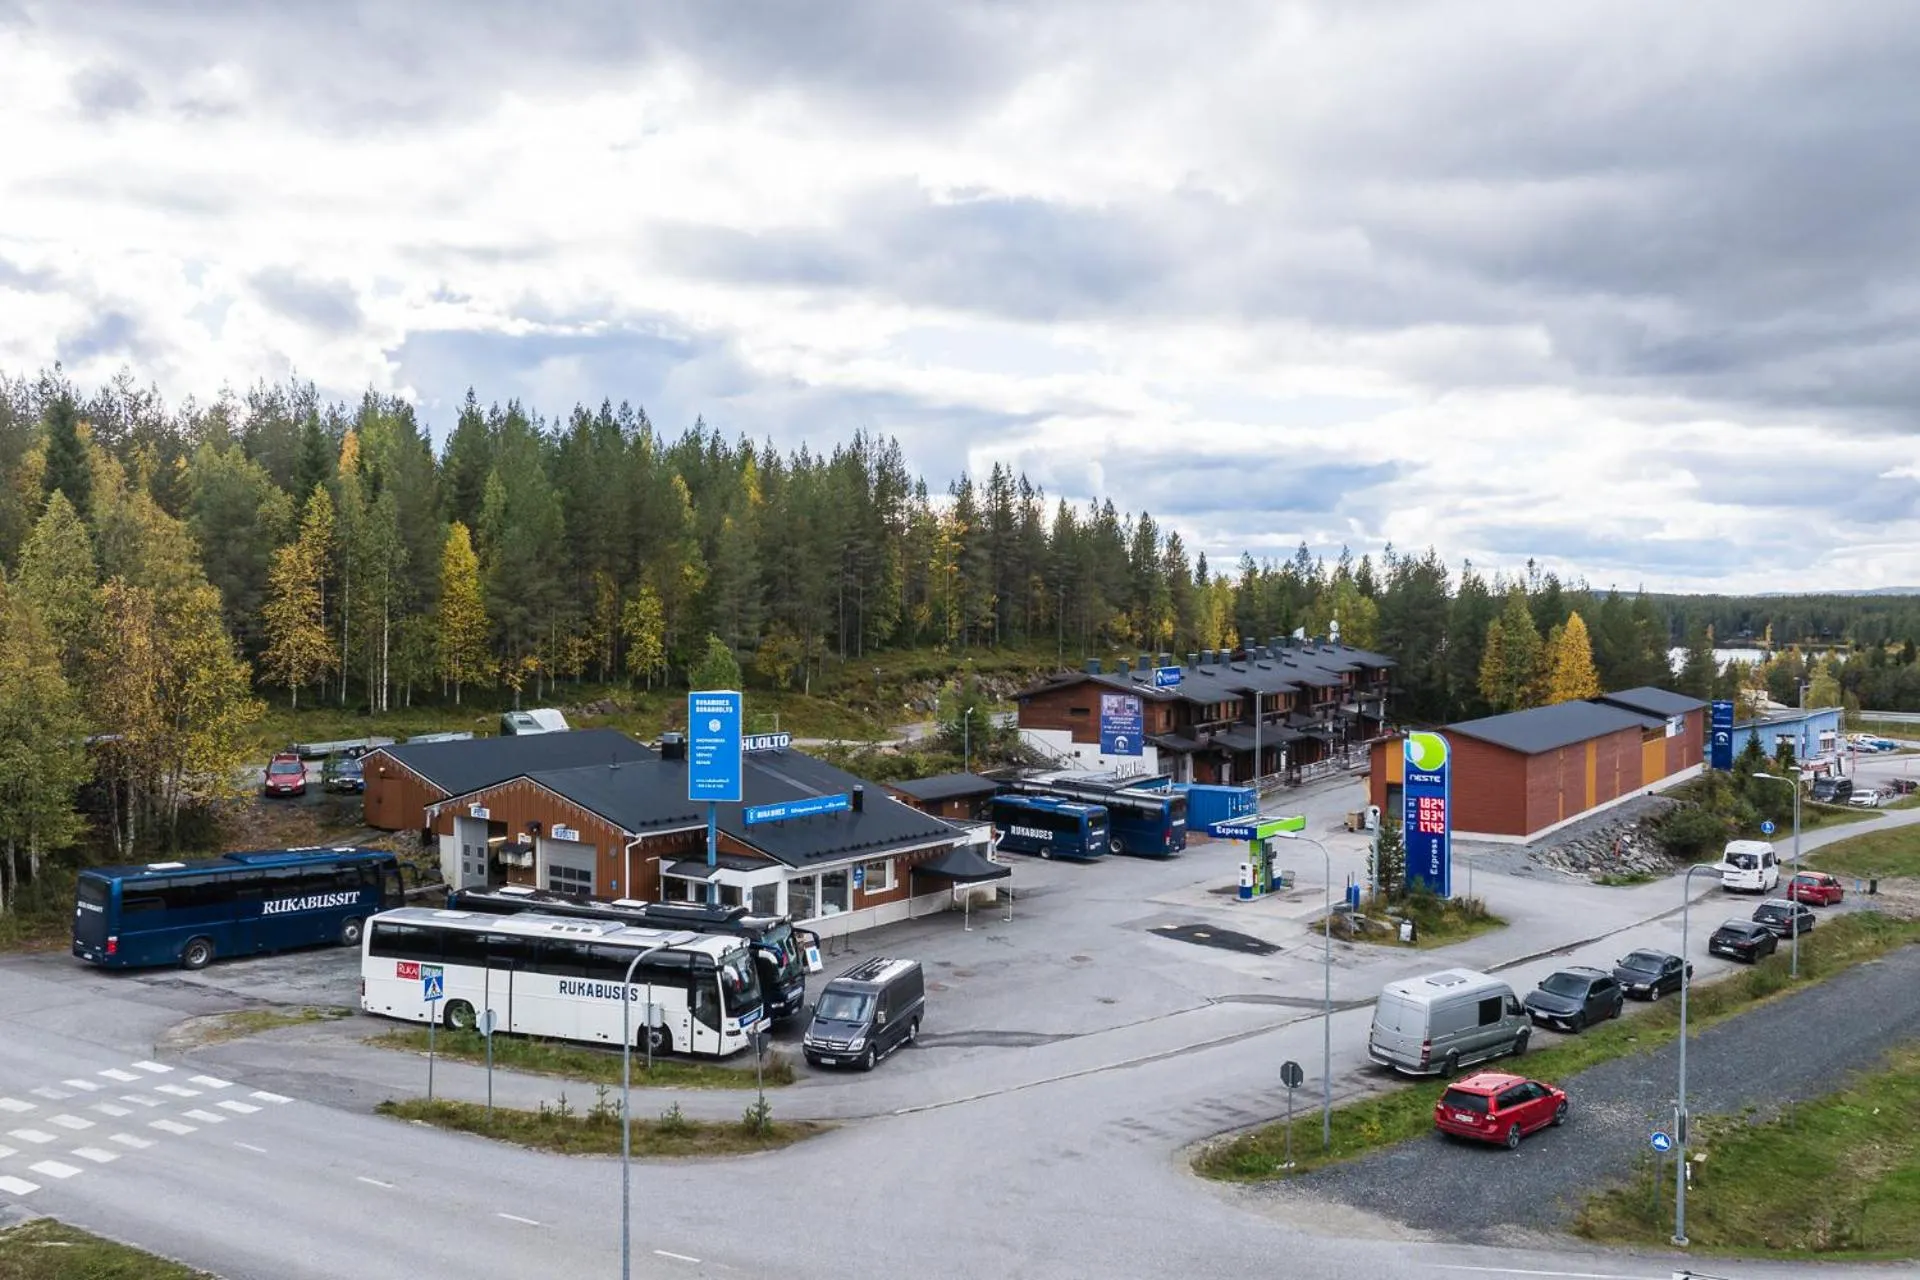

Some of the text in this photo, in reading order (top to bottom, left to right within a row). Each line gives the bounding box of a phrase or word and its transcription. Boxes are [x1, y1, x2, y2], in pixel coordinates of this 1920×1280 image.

[741, 735, 789, 751] HUOLTO
[1216, 825, 1249, 836] Express
[1430, 839, 1439, 875] Express
[261, 890, 361, 916] RUKABUSSIT
